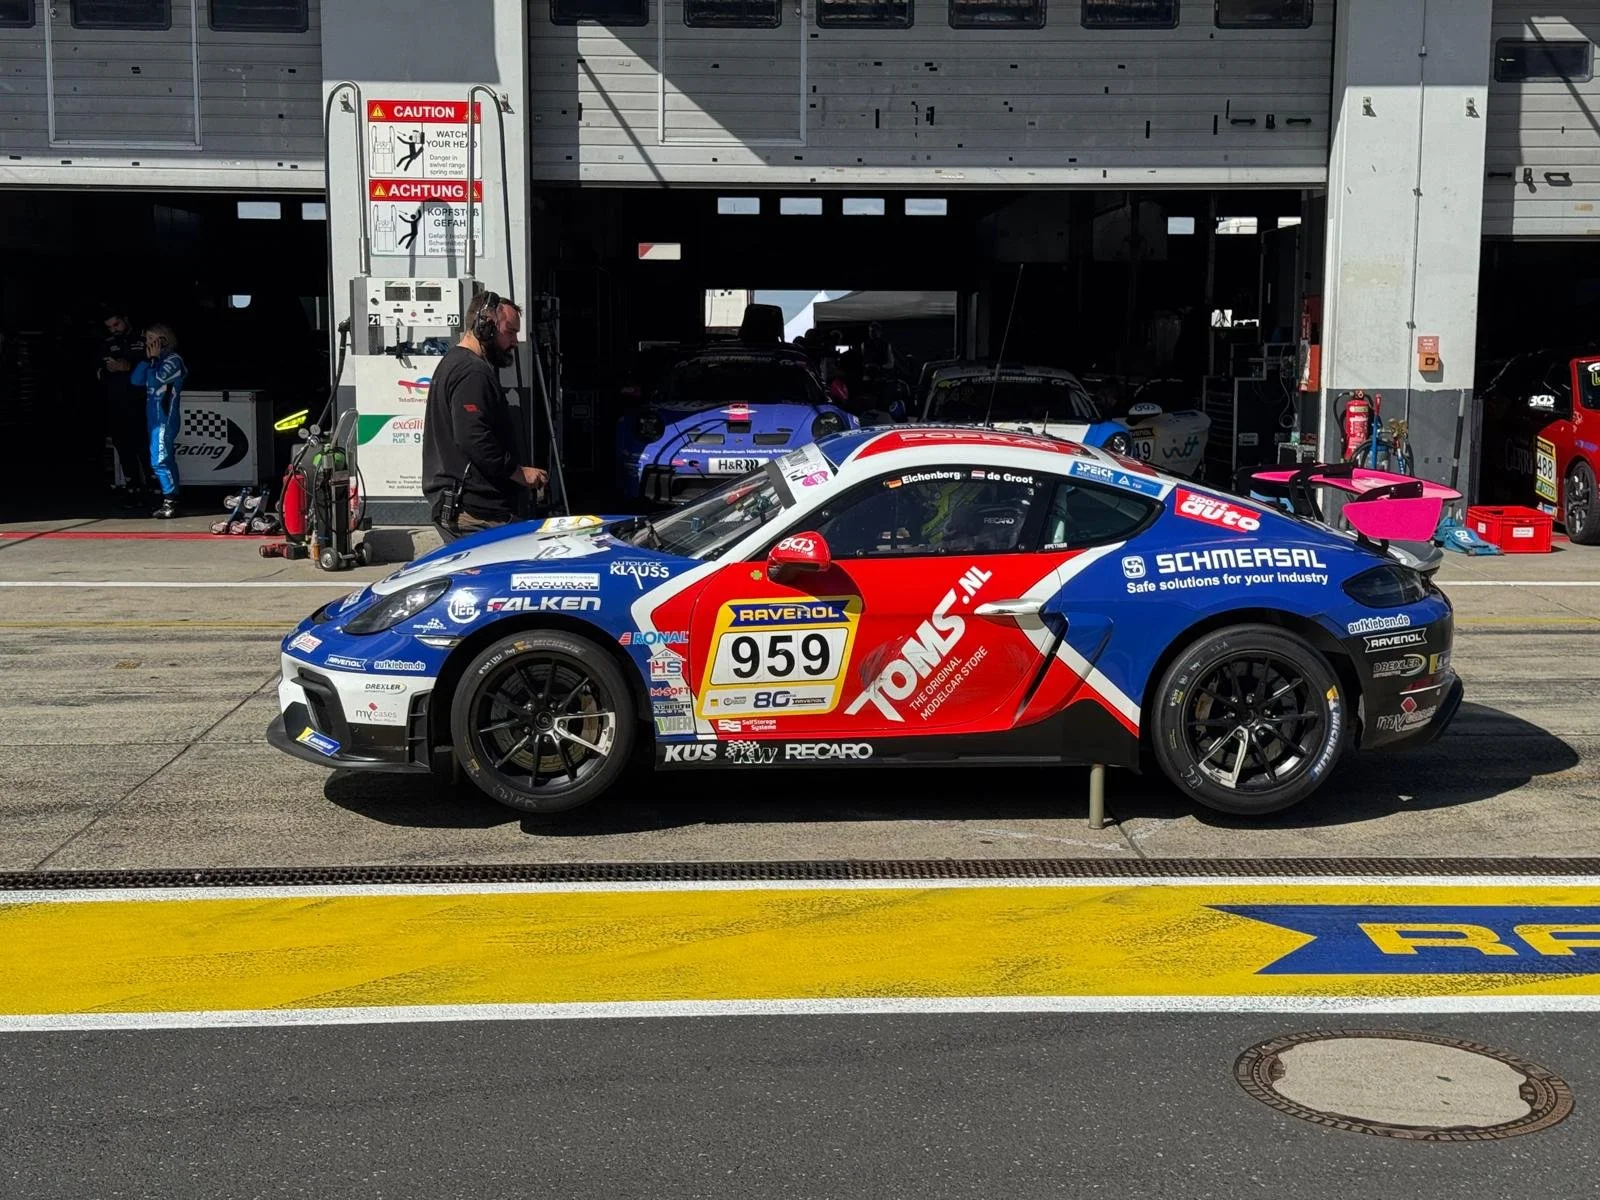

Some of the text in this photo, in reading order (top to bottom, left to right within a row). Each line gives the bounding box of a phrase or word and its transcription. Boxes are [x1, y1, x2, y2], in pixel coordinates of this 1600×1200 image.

[393, 106, 455, 118] CAUTION
[427, 140, 478, 148] YOUR HED
[389, 184, 464, 197] ACHTUNG
[427, 208, 480, 217] KOPFSTß
[369, 315, 380, 325] 21
[448, 315, 460, 325] 20
[393, 417, 424, 429] excelli
[413, 432, 424, 443] 9
[718, 459, 743, 471] H&R
[987, 472, 1001, 481] de
[1003, 473, 1034, 485] Groot
[1186, 494, 1229, 511] sport
[1180, 501, 1260, 532] auto
[1156, 548, 1327, 574] SCHMERSAL
[609, 565, 670, 590] KLAUSS
[1127, 571, 1329, 594] Safe solutions for your industry
[486, 596, 601, 612] FALKEN
[739, 606, 840, 622] RAVENOL
[1348, 614, 1410, 635] aufkleben.de
[633, 631, 689, 645] RONAL
[1370, 635, 1422, 649] RAVENOL
[731, 633, 830, 679] 959
[373, 659, 426, 672] aufkleben.de
[652, 661, 682, 674] HS
[920, 645, 988, 721] MODELCAR STORE
[926, 656, 963, 695] ORIGINAL
[365, 683, 401, 691] DREXLER
[909, 693, 927, 711] THE
[785, 743, 873, 760] RECARO
[1312, 712, 1340, 776] MICHELIN
[664, 743, 718, 763] KÜS
